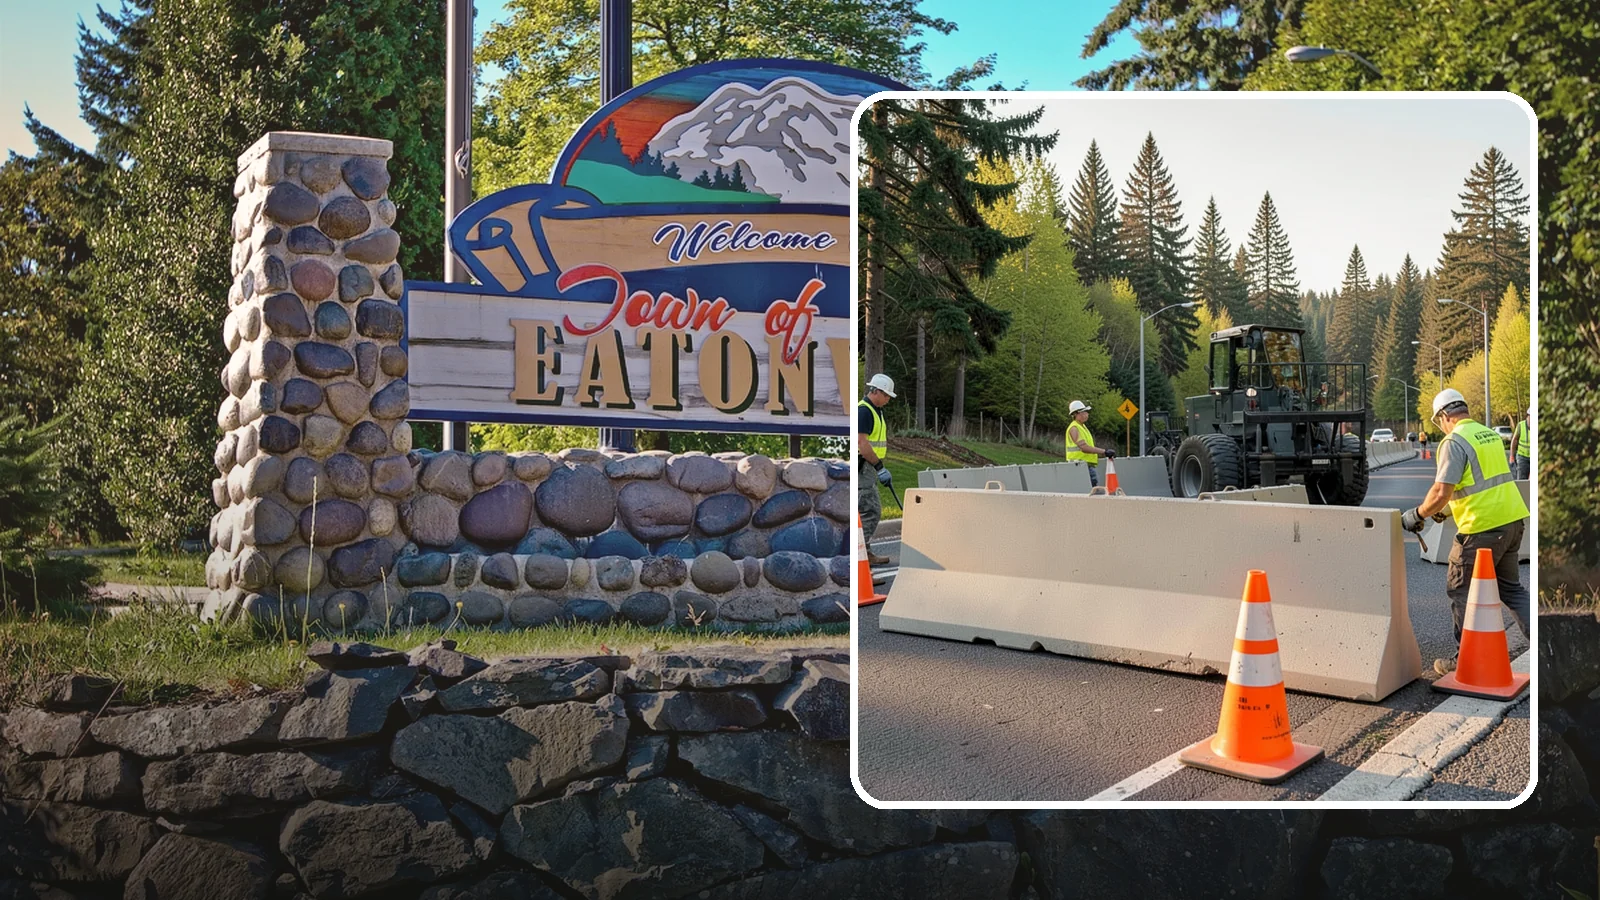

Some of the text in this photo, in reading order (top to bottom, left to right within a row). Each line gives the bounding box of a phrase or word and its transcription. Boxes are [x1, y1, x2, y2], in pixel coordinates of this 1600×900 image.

[653, 220, 837, 263] Welcome
[557, 263, 826, 366] Town of
